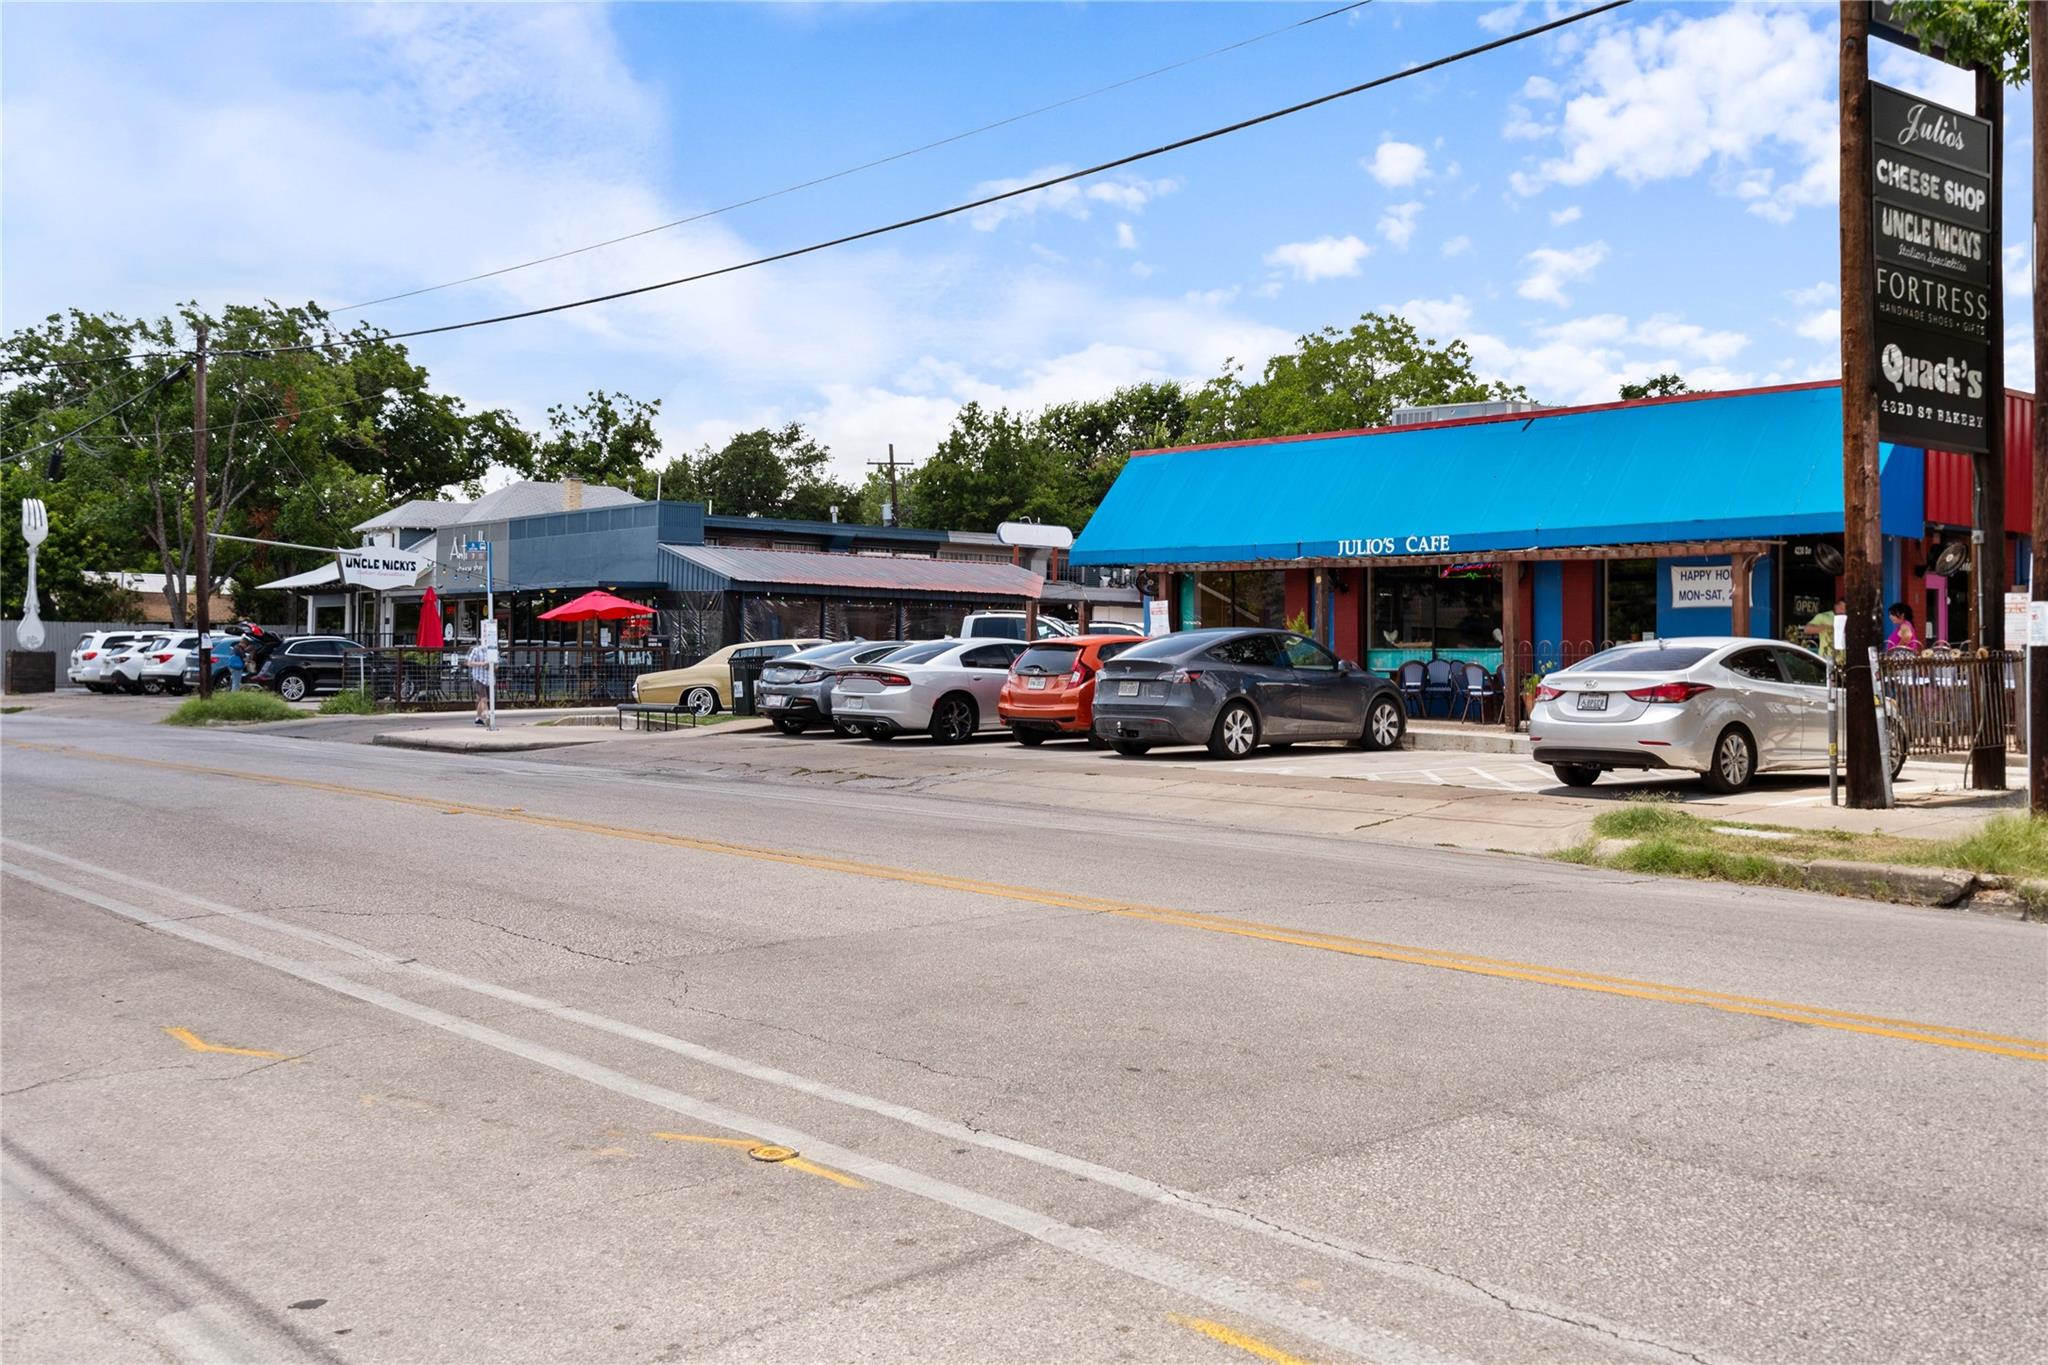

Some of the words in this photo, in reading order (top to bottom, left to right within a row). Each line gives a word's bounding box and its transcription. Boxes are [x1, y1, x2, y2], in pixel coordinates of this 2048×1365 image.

[1897, 104, 1965, 150] Julio's
[1876, 158, 1941, 200] CHEESE
[1943, 180, 1986, 213] SHOP
[1882, 206, 1931, 247] UNCLE
[1877, 267, 1988, 320] FORTRESS
[1880, 302, 1925, 321] HANDMADE
[1928, 313, 1953, 328] SHOES
[1881, 343, 1983, 399] Quack's
[1881, 399, 1914, 417] 43RD
[1917, 406, 1934, 420] ST
[1937, 409, 1984, 428] BAKERY
[1338, 537, 1395, 556] JULIO'S
[1405, 535, 1451, 553] CAFE
[345, 557, 380, 570] UNCLE
[1680, 569, 1713, 581] HAPPY
[1715, 568, 1734, 581] HO
[1795, 599, 1820, 613] OPEN
